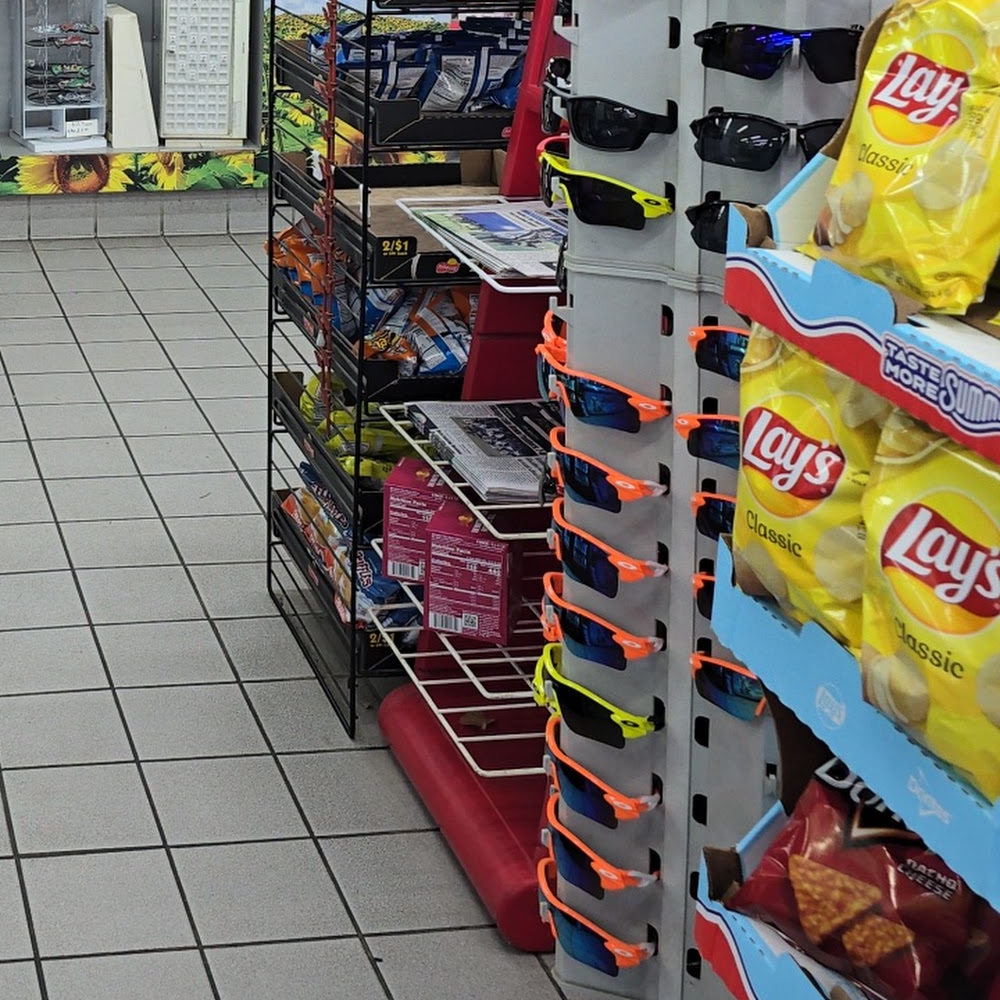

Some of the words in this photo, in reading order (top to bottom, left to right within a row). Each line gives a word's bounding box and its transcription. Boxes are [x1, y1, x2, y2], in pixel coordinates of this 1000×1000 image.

[382, 239, 409, 251] 2/$1
[886, 341, 940, 383] TASTE
[886, 361, 939, 401] MORE
[742, 409, 842, 492] Lay's
[746, 509, 803, 558] Classic
[897, 864, 954, 900] CHEESE
